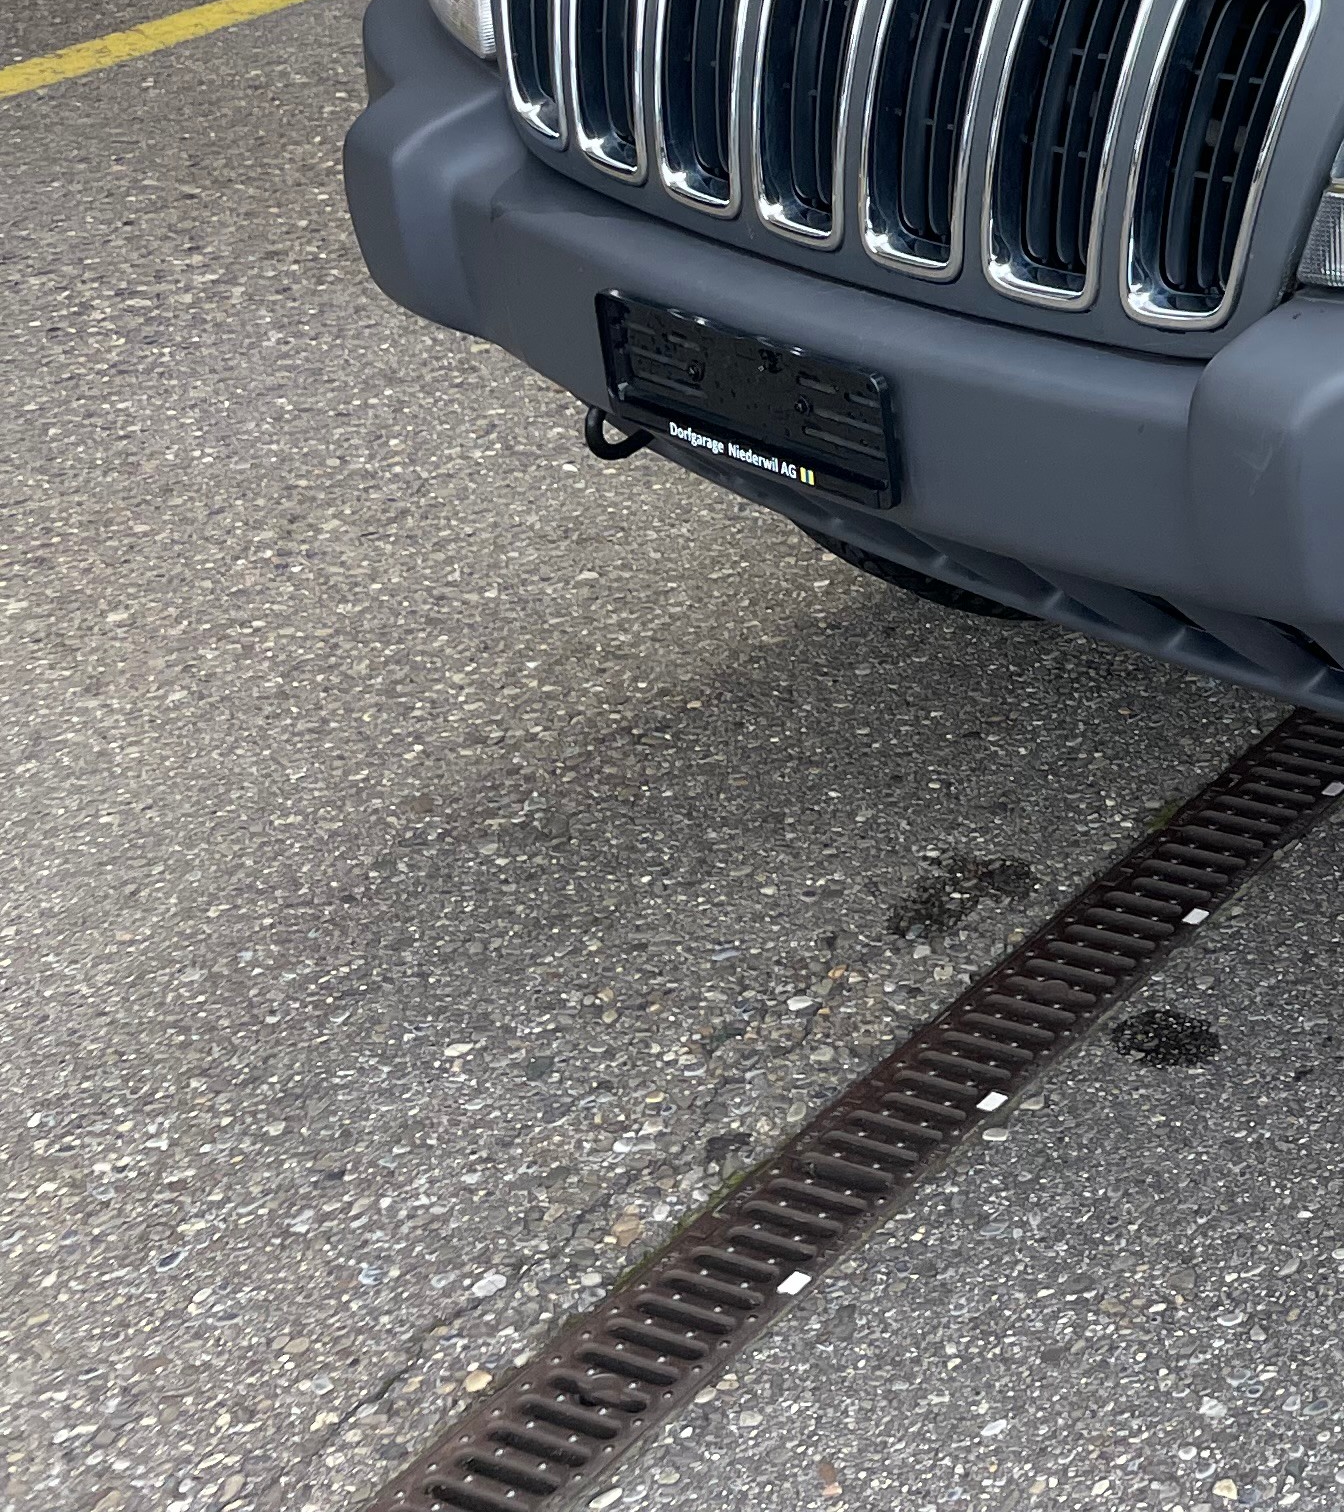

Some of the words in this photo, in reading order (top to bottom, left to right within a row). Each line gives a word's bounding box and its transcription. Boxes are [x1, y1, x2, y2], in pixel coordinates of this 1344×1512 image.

[668, 421, 725, 455] Dorfgarage
[727, 442, 779, 473] Niederwil
[780, 461, 797, 479] AG
